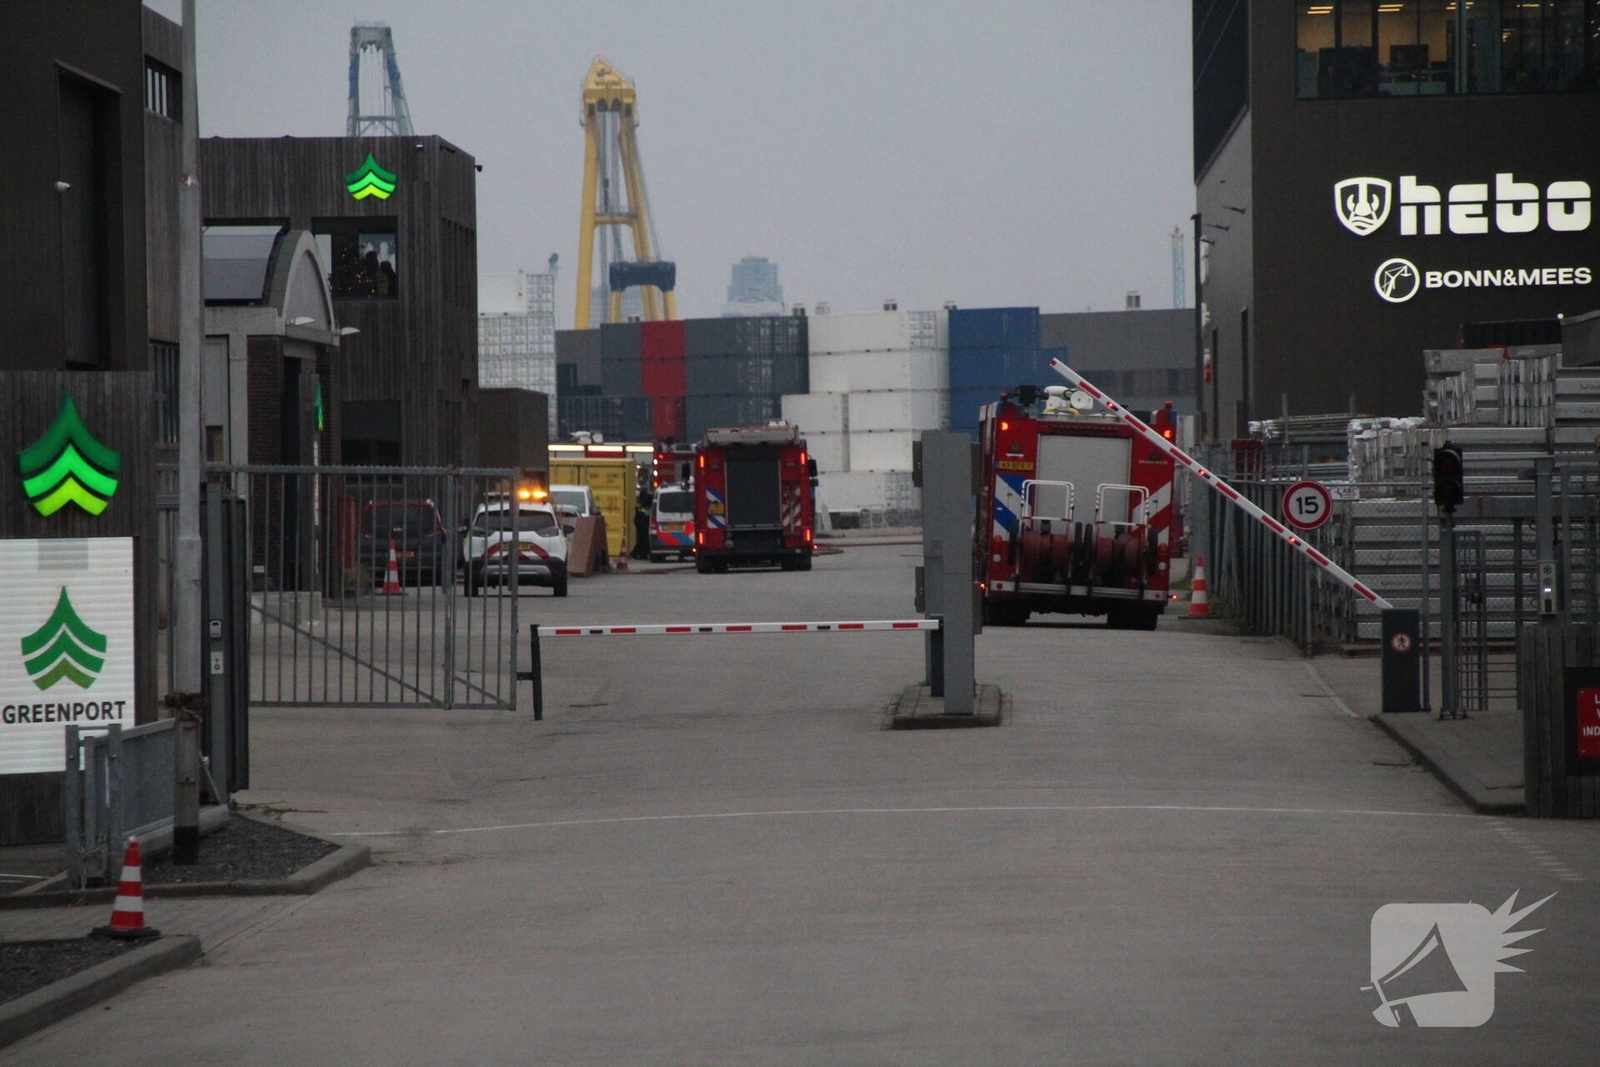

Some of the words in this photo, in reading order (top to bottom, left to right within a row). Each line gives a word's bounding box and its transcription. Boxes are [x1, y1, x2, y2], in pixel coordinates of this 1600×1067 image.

[1399, 172, 1592, 236] hebo
[1425, 267, 1592, 288] BONN&MEES
[1296, 496, 1319, 515] 15
[3, 701, 126, 724] GREENPORT
